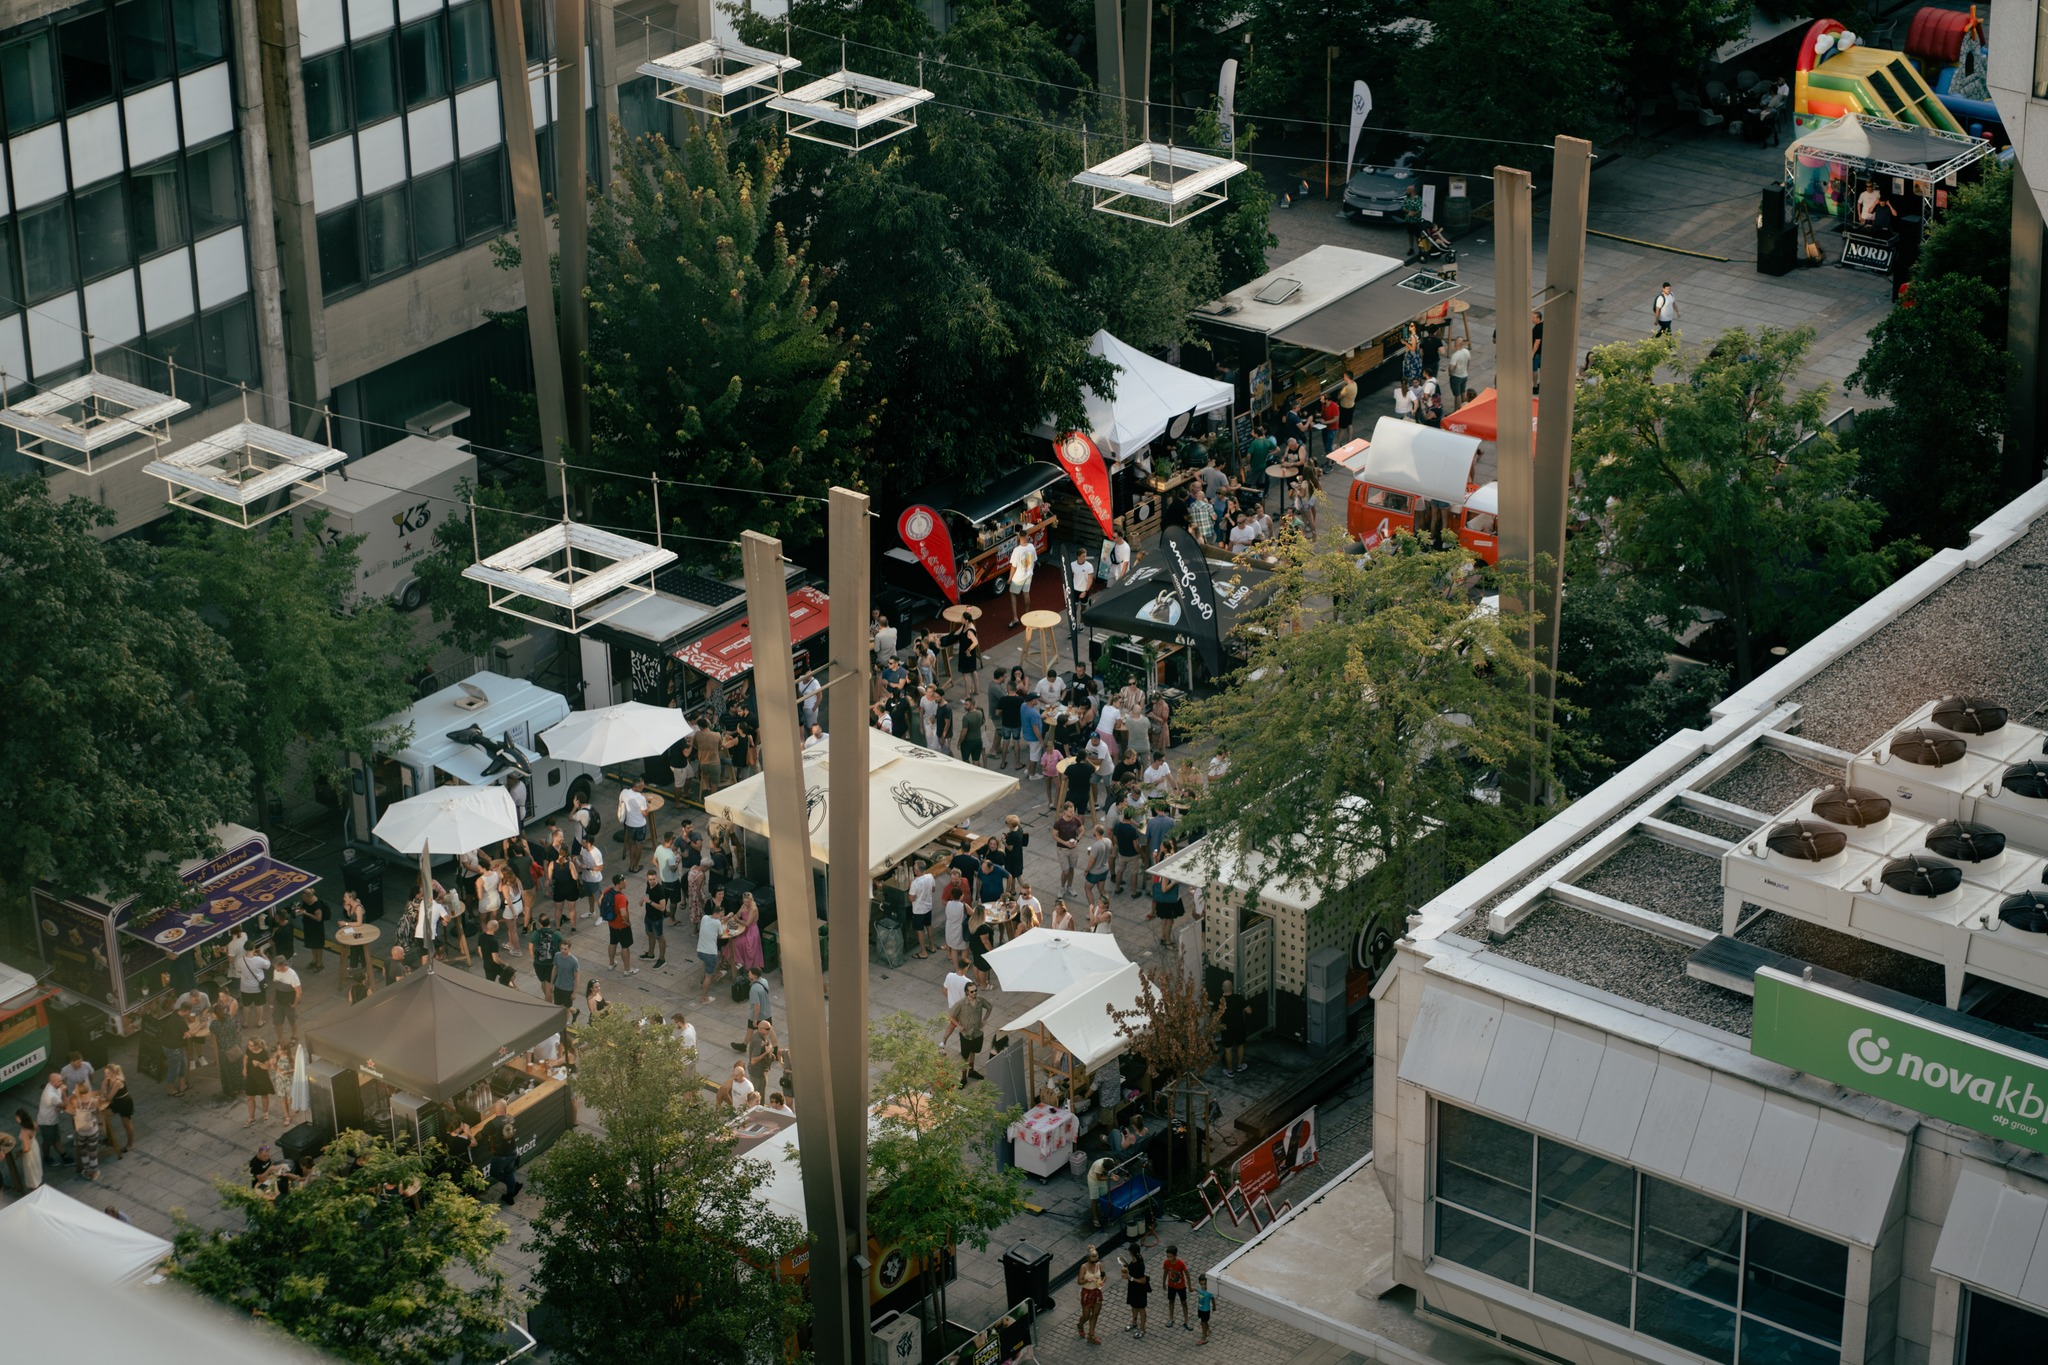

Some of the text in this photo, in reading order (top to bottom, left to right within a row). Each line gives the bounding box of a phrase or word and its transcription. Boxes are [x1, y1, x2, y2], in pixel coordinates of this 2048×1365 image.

[1848, 243, 1888, 260] NORD
[394, 500, 431, 538] K3
[392, 548, 425, 569] Heineken
[211, 850, 249, 875] Thailand
[199, 863, 256, 896] HAIFOOD
[1992, 1114, 2038, 1136] otp group
[975, 1339, 998, 1360] STREET
[976, 1347, 998, 1365] FOOD
